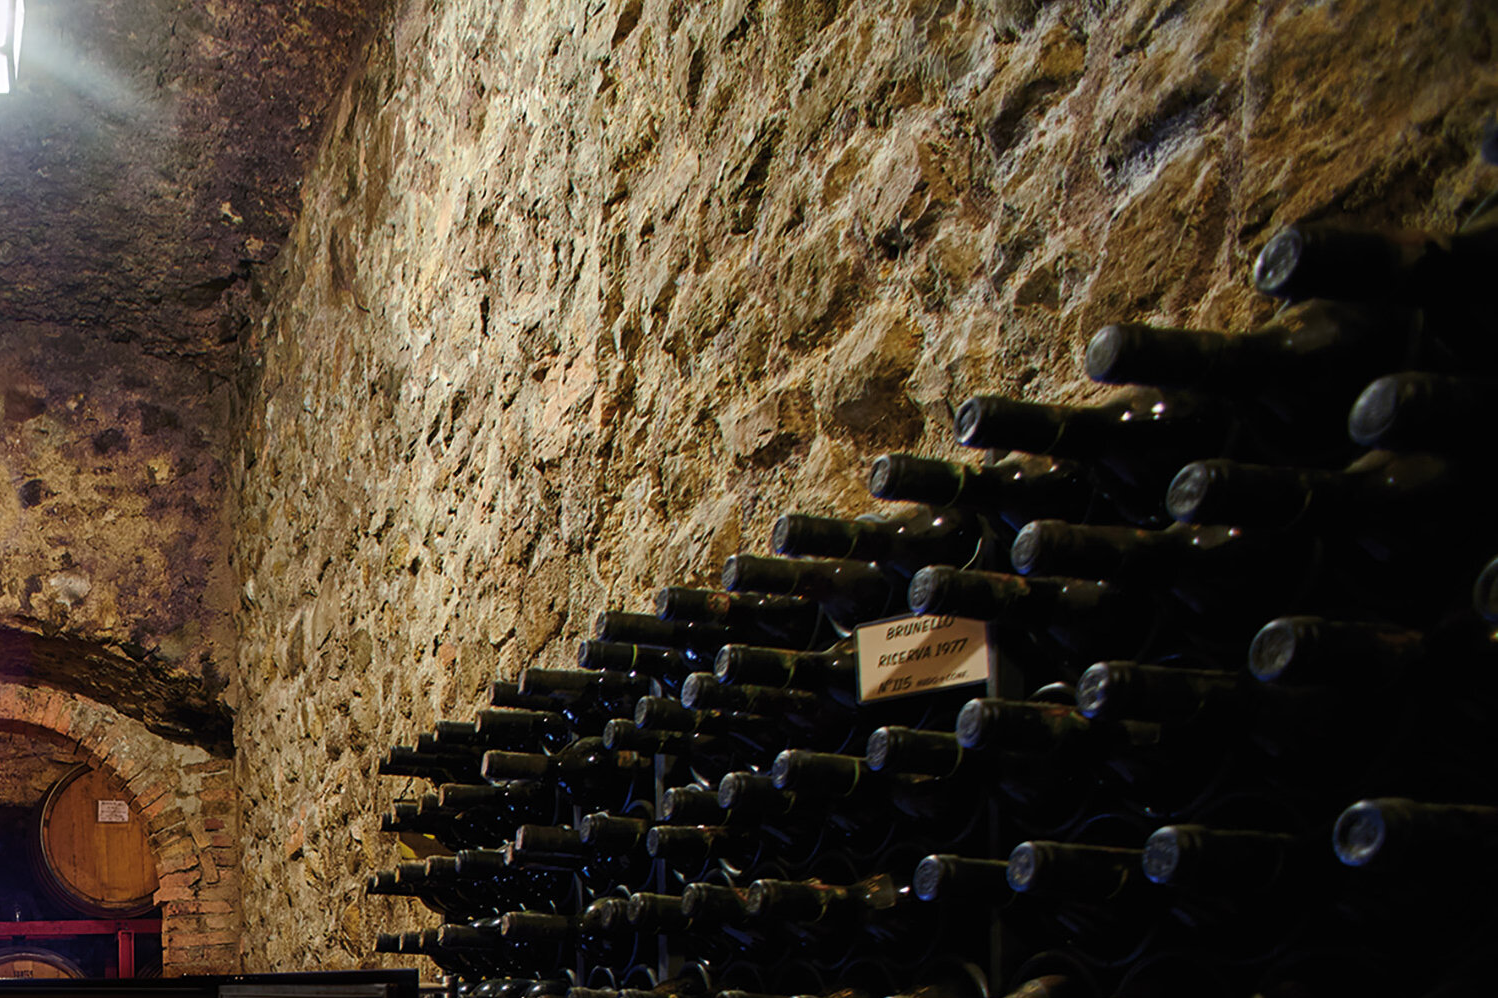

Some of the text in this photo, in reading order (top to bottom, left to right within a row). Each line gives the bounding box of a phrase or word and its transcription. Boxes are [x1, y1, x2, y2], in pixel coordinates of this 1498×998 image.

[886, 616, 955, 640] BRUNELLO
[878, 638, 968, 668] RISERVA 1977
